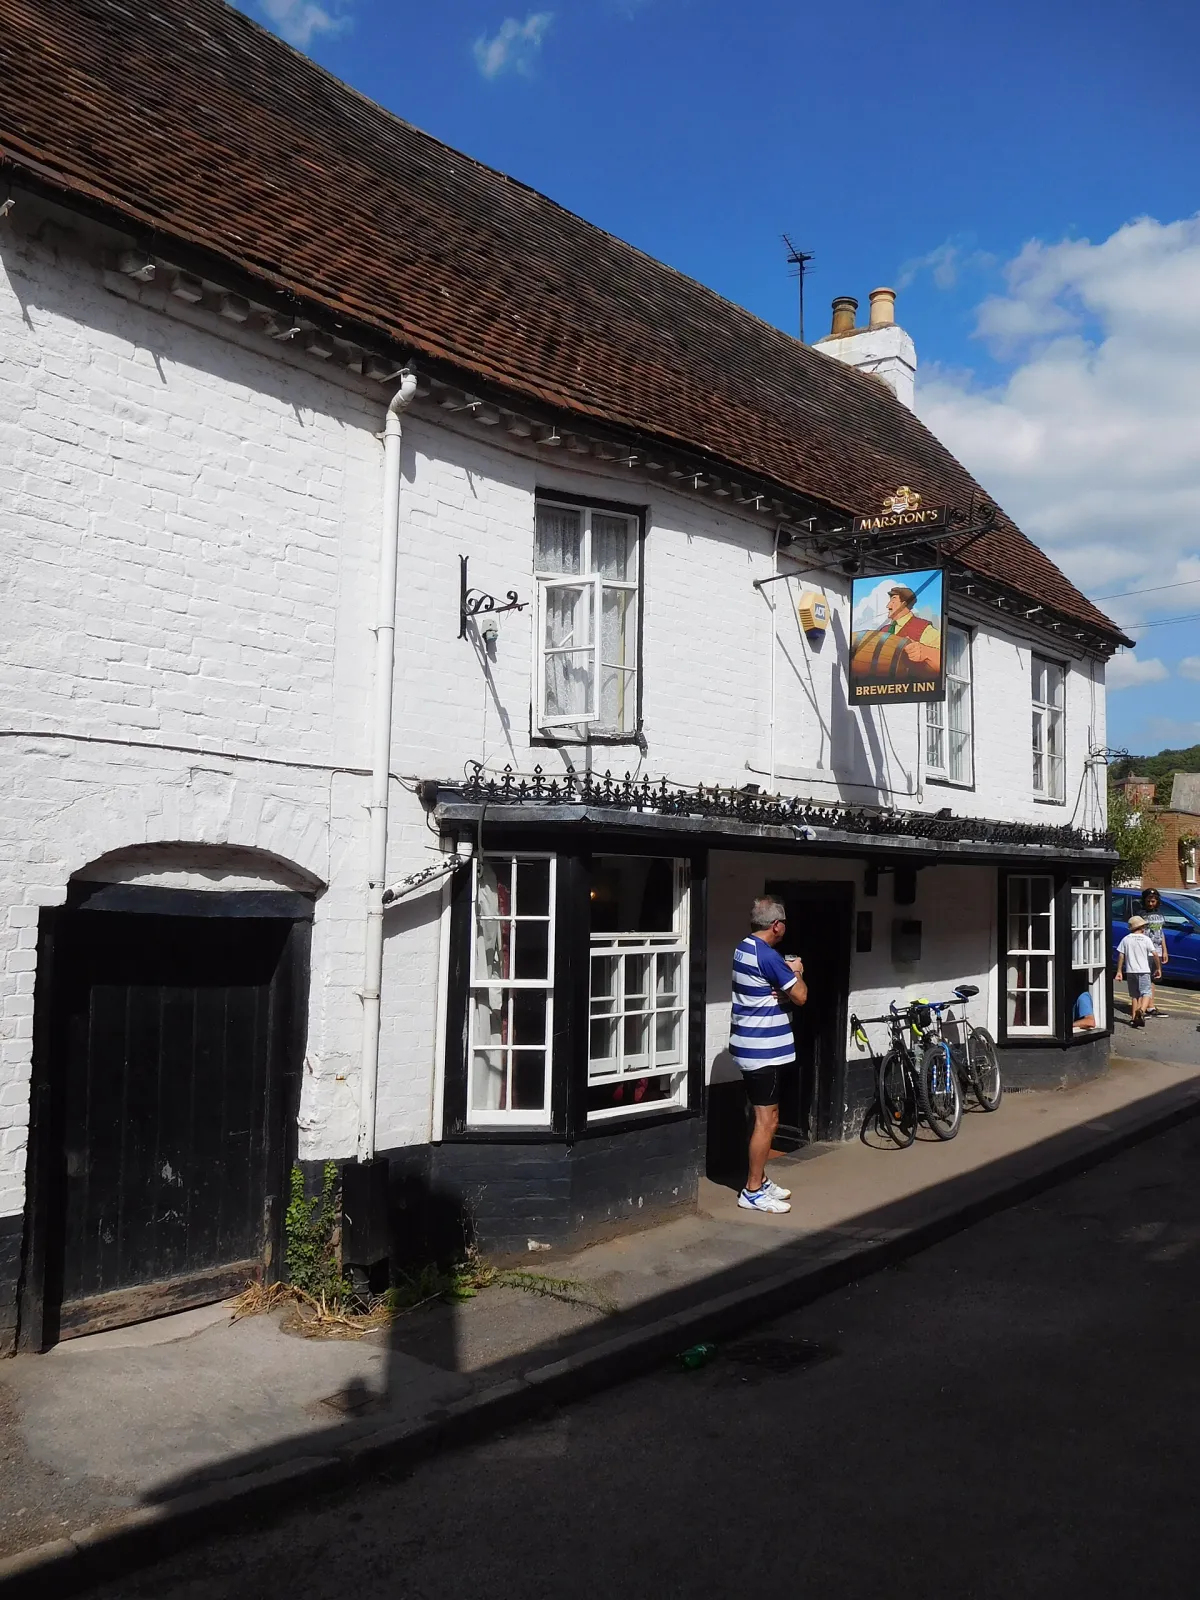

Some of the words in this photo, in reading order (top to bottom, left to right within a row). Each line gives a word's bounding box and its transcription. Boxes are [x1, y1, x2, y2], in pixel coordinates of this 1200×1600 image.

[859, 509, 938, 531] MARSTON'S
[856, 683, 909, 696] BREWERY
[913, 681, 935, 693] INN
